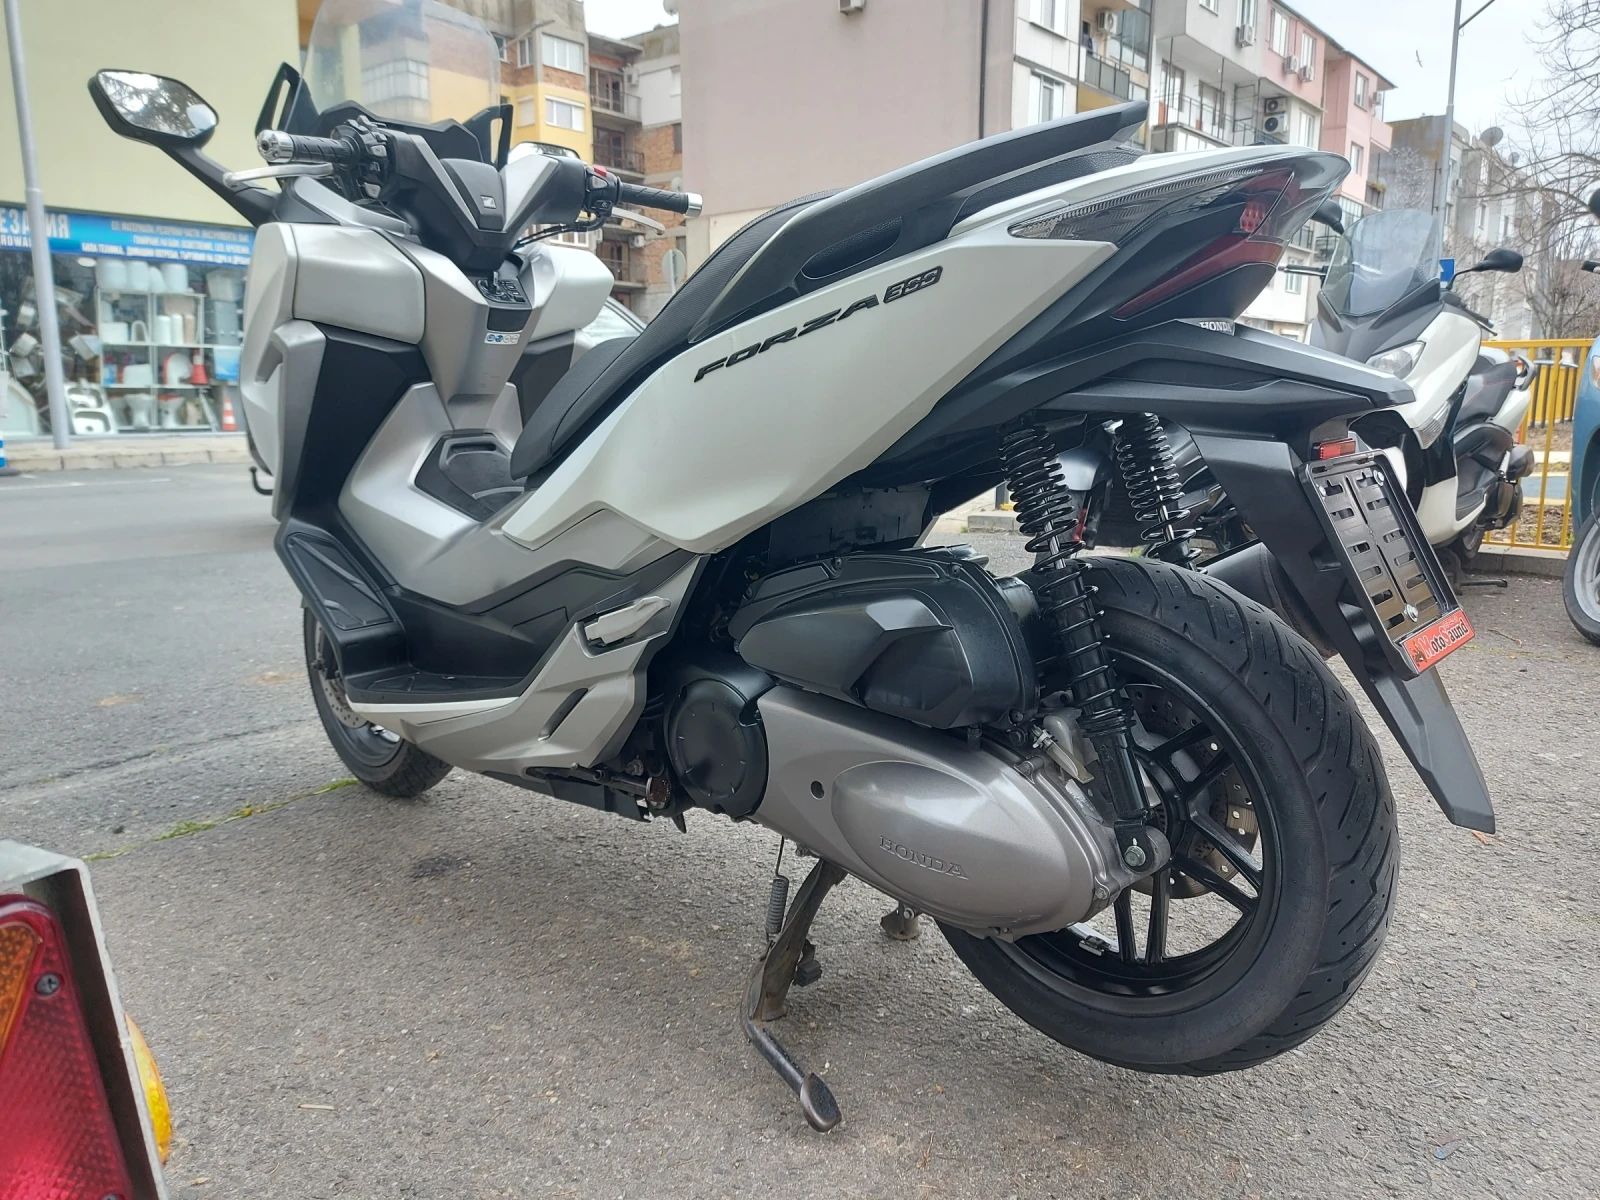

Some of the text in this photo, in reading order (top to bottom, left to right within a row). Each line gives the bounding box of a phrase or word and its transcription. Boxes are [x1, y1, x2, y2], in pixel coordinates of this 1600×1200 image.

[693, 294, 880, 383] FORZA
[1199, 321, 1233, 332] HONDA
[880, 835, 969, 880] HONDA
